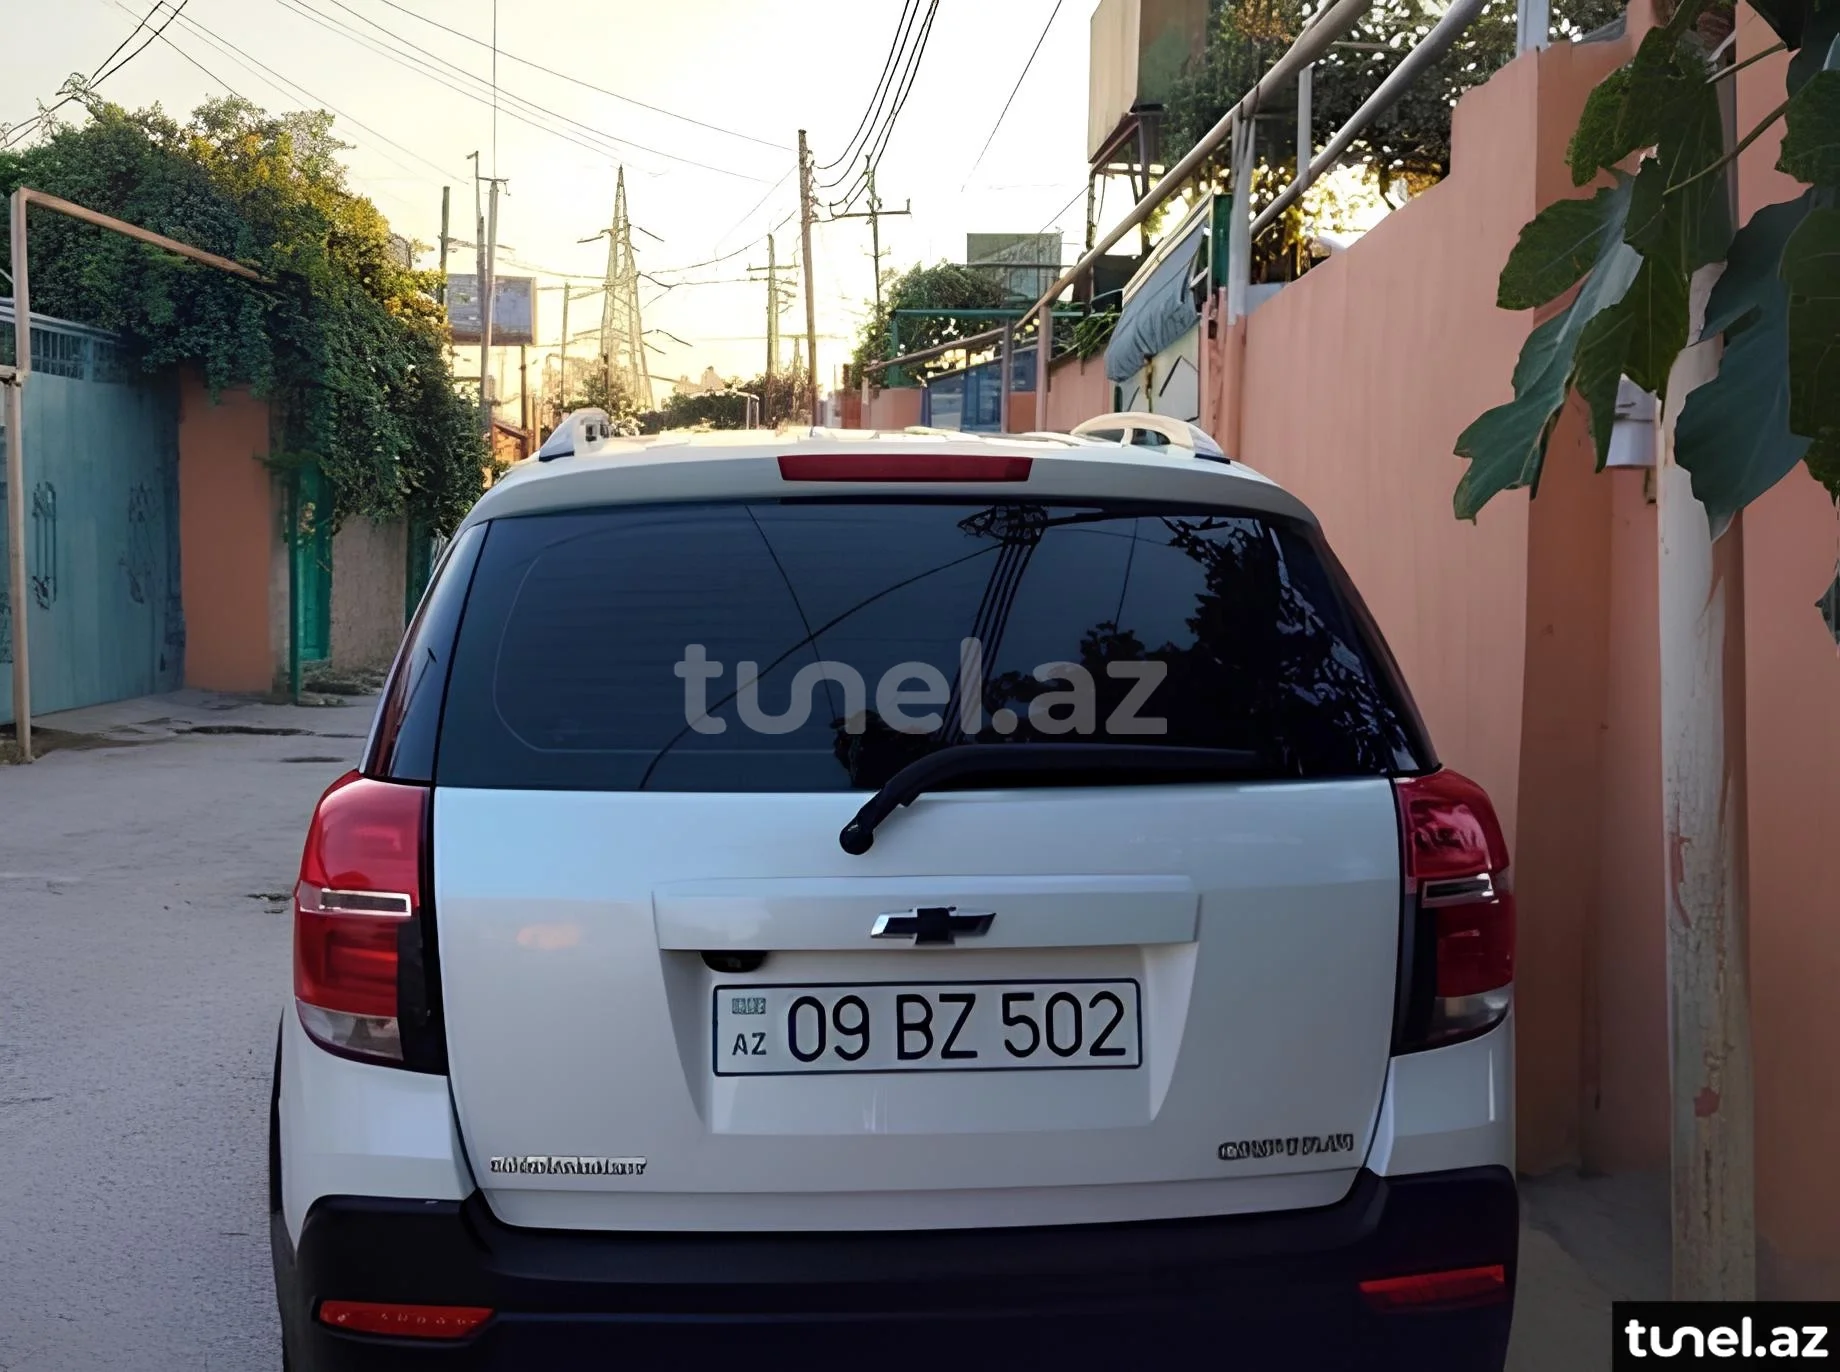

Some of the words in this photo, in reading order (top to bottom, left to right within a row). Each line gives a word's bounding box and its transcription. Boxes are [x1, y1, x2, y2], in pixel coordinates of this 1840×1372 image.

[732, 1032, 767, 1056] AZ
[788, 995, 870, 1062] 09
[896, 993, 978, 1060] BZ
[1001, 991, 1126, 1058] 502
